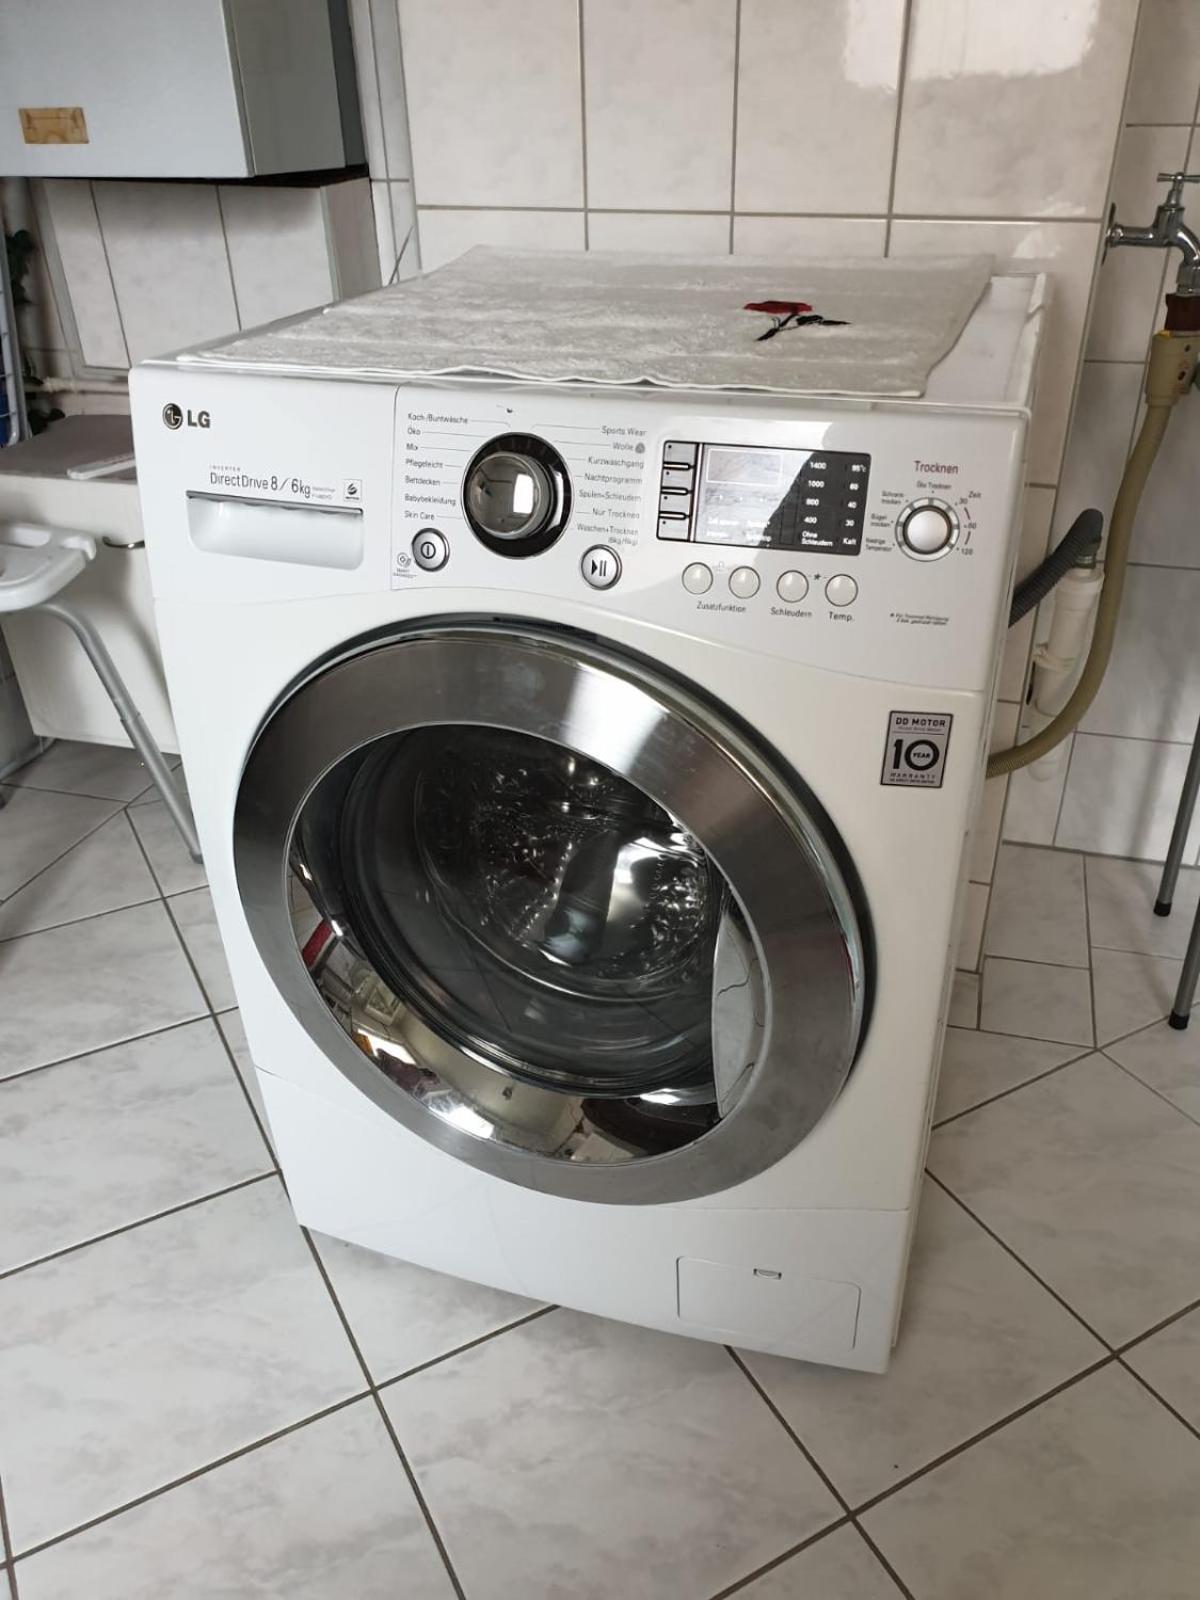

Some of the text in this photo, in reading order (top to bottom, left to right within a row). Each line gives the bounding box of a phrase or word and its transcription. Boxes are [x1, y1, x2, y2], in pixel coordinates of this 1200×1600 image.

[187, 409, 210, 428] LG
[601, 425, 647, 436] Sports Wear
[406, 443, 419, 451] Mix
[613, 442, 634, 451] Wolle
[405, 458, 443, 469] Pflegeleicht
[588, 456, 644, 469] Kurzwaschgang
[810, 461, 827, 469] 1400
[914, 460, 959, 474] Trocknen
[405, 475, 440, 486] Bettdecken
[585, 472, 643, 484] Nachtprogramm
[271, 475, 278, 491] 8
[291, 478, 311, 499] 6kg
[808, 480, 825, 488] 1000
[968, 490, 982, 498] Zeit
[405, 493, 456, 507] Babybekleidung
[806, 498, 819, 506] 800
[848, 501, 857, 509] 40
[404, 511, 435, 521] Skin Care
[593, 507, 640, 519] Nur Trocknen
[804, 516, 818, 524] 400
[845, 519, 855, 527] 30
[802, 530, 818, 538] Ohne
[801, 537, 833, 547] Schleudern
[697, 600, 747, 613] Zusatzfunktion
[771, 606, 813, 618] Schleudern
[829, 611, 855, 622] Temp.
[895, 716, 946, 727] DD MOTOR
